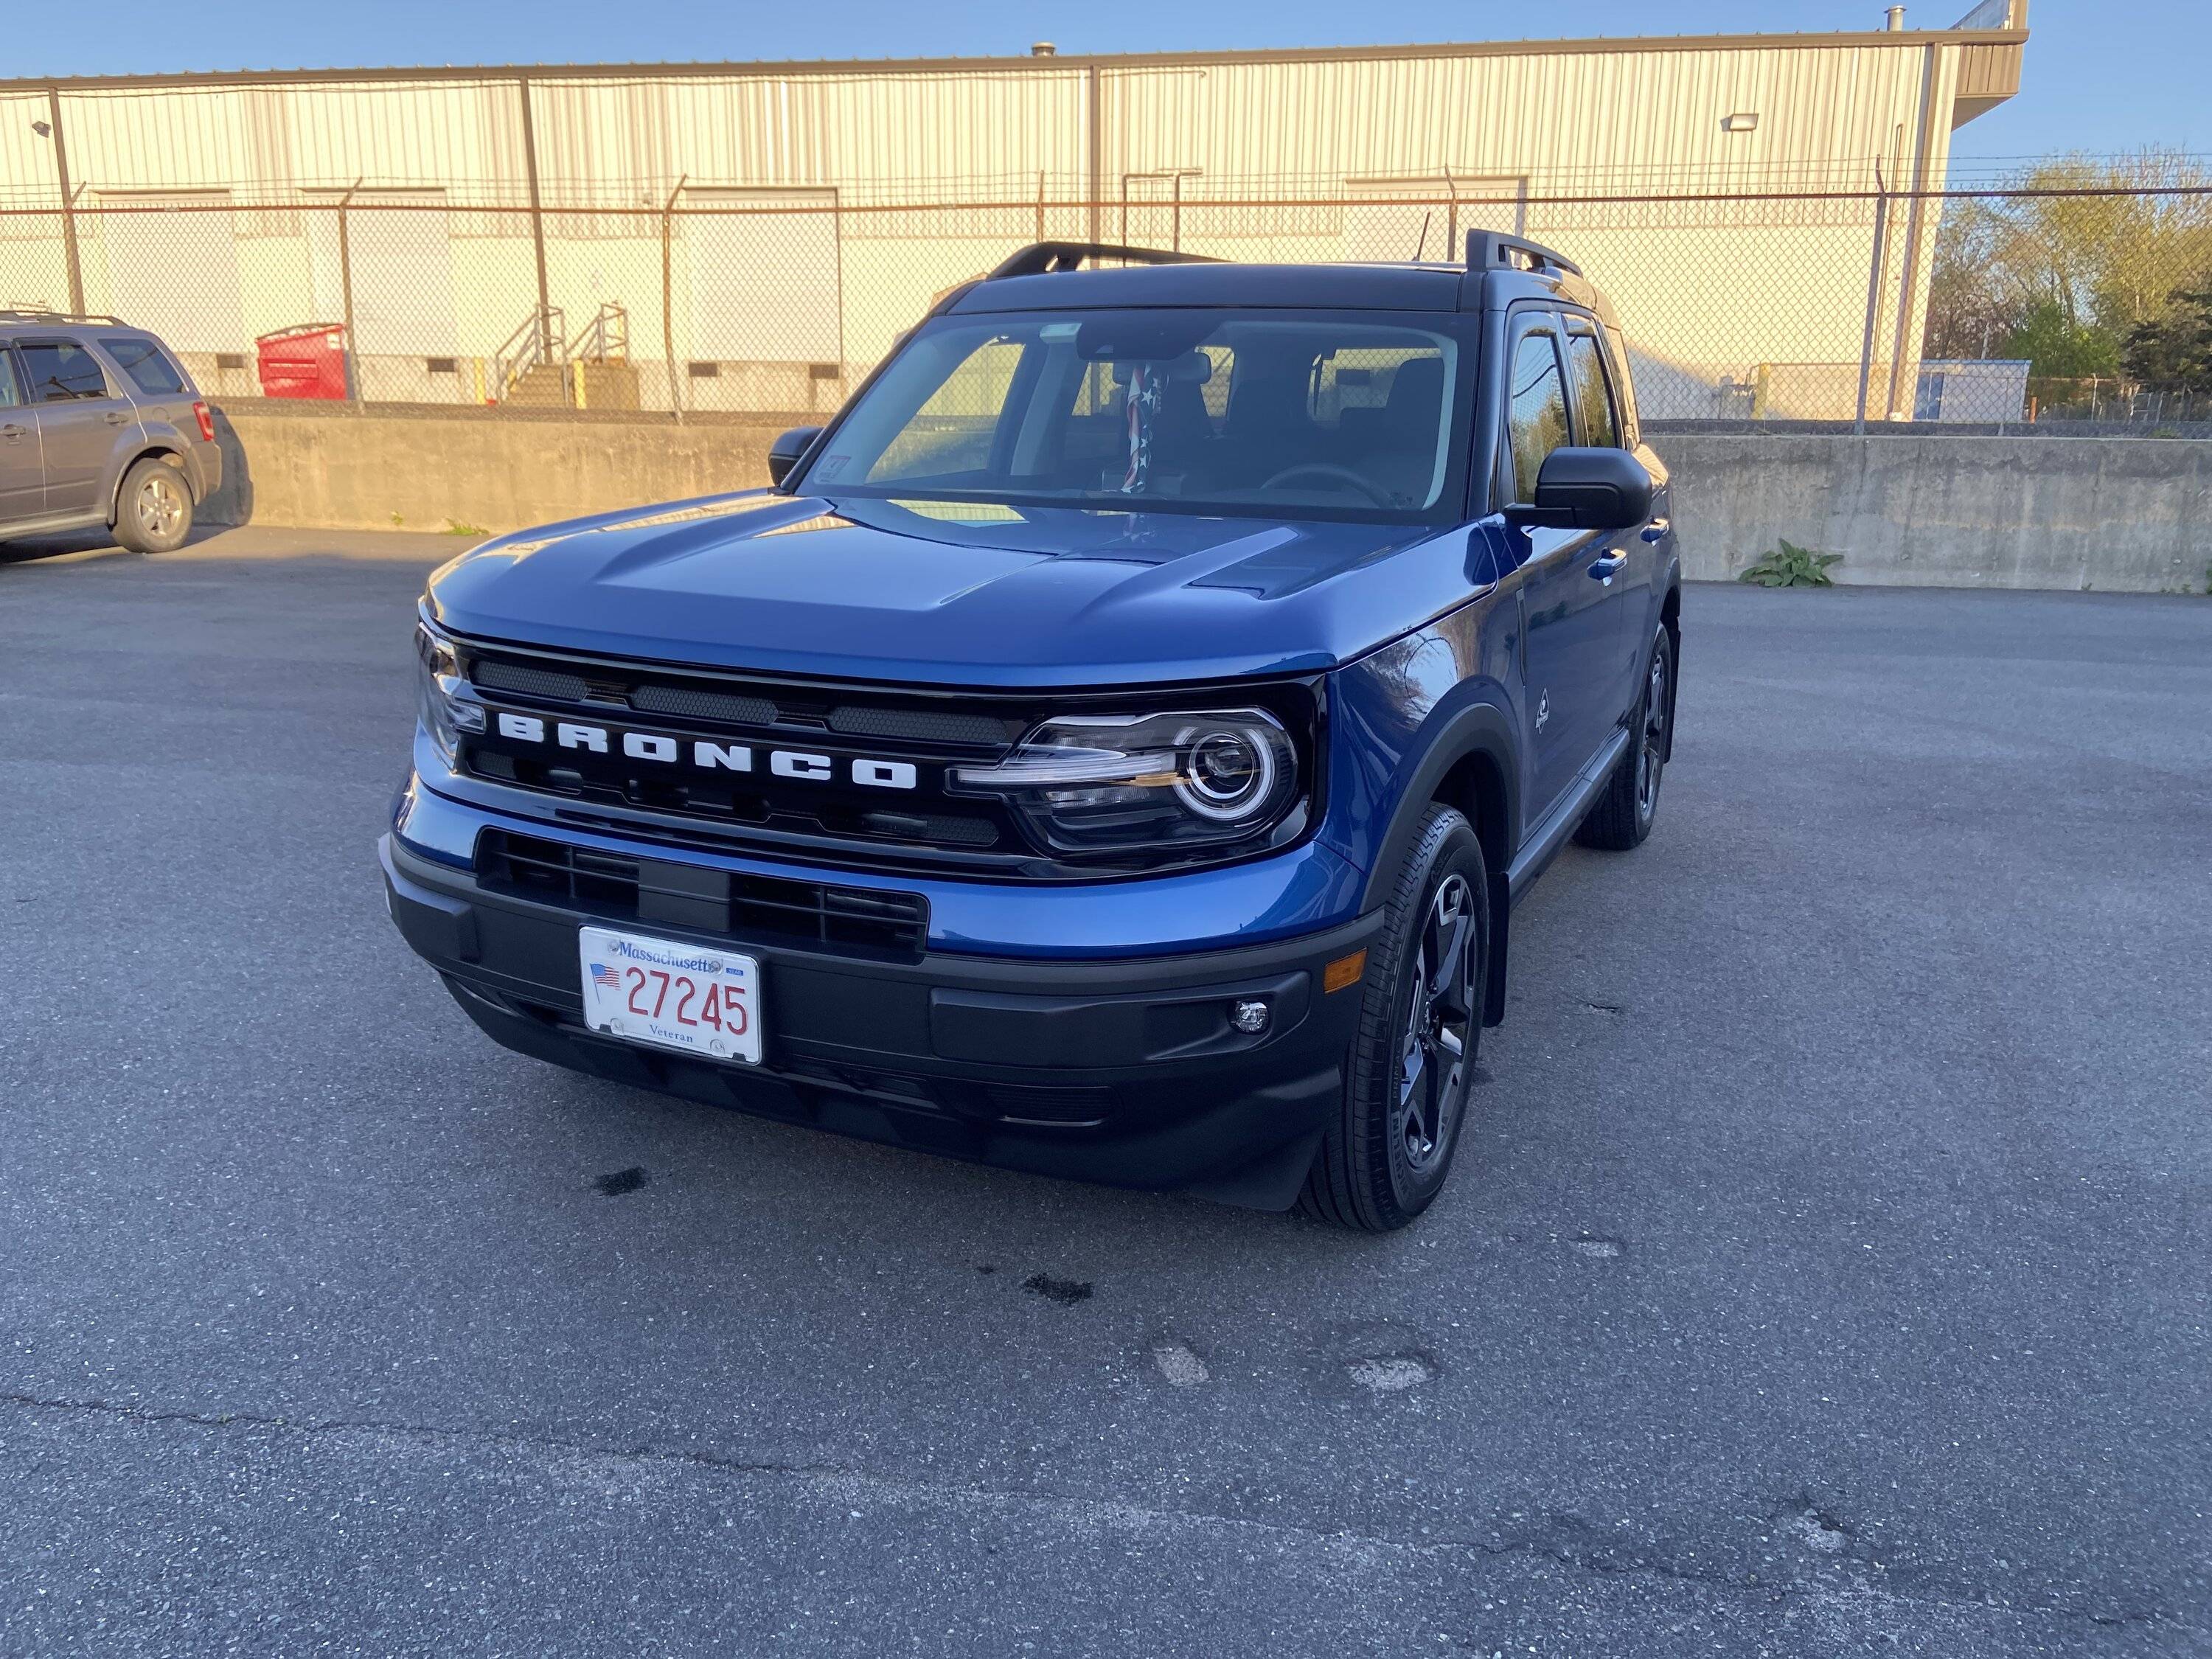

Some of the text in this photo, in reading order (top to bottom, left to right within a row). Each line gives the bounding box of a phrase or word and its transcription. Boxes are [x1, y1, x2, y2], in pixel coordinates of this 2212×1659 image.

[498, 712, 916, 788] BRONCO
[626, 967, 748, 1035] 27245
[650, 1024, 693, 1043] Veteran
